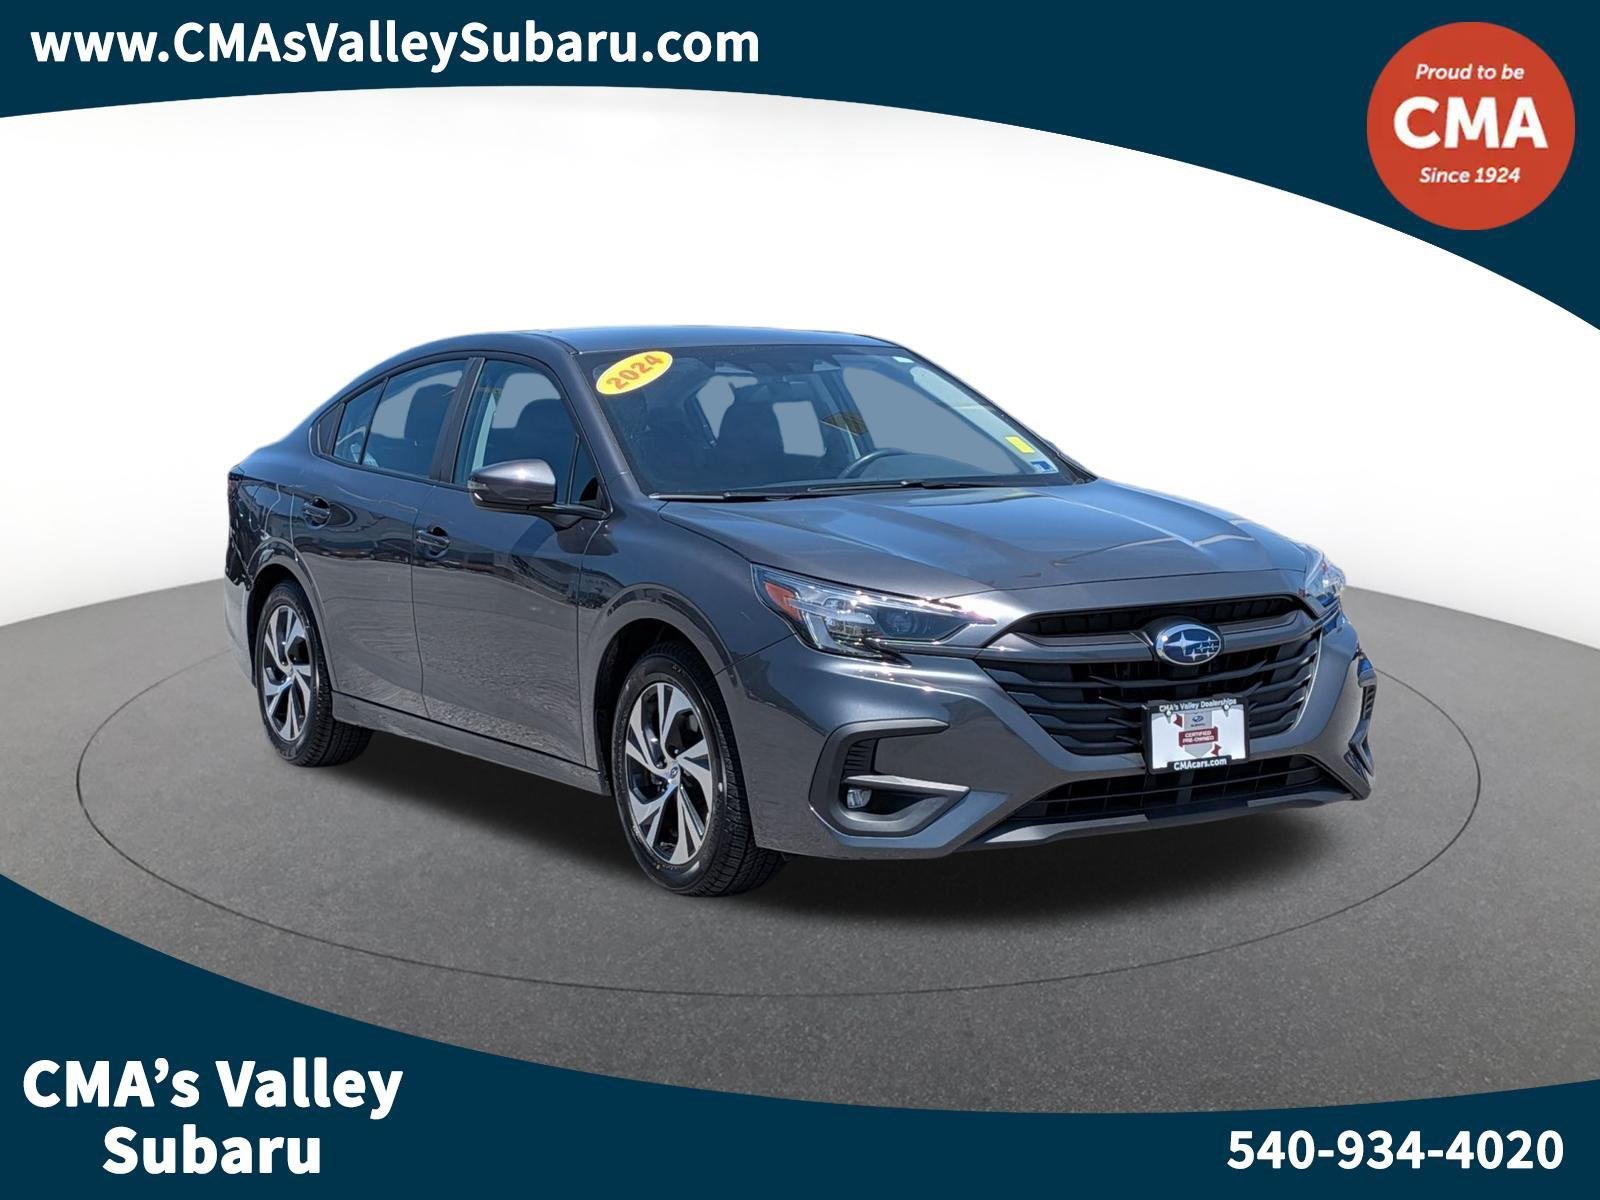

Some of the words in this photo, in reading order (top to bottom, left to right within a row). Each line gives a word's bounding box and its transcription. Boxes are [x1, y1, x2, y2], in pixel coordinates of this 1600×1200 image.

[606, 355, 664, 390] 2024
[1180, 702, 1200, 711] Valley
[1173, 758, 1227, 771] CMAcars.com
